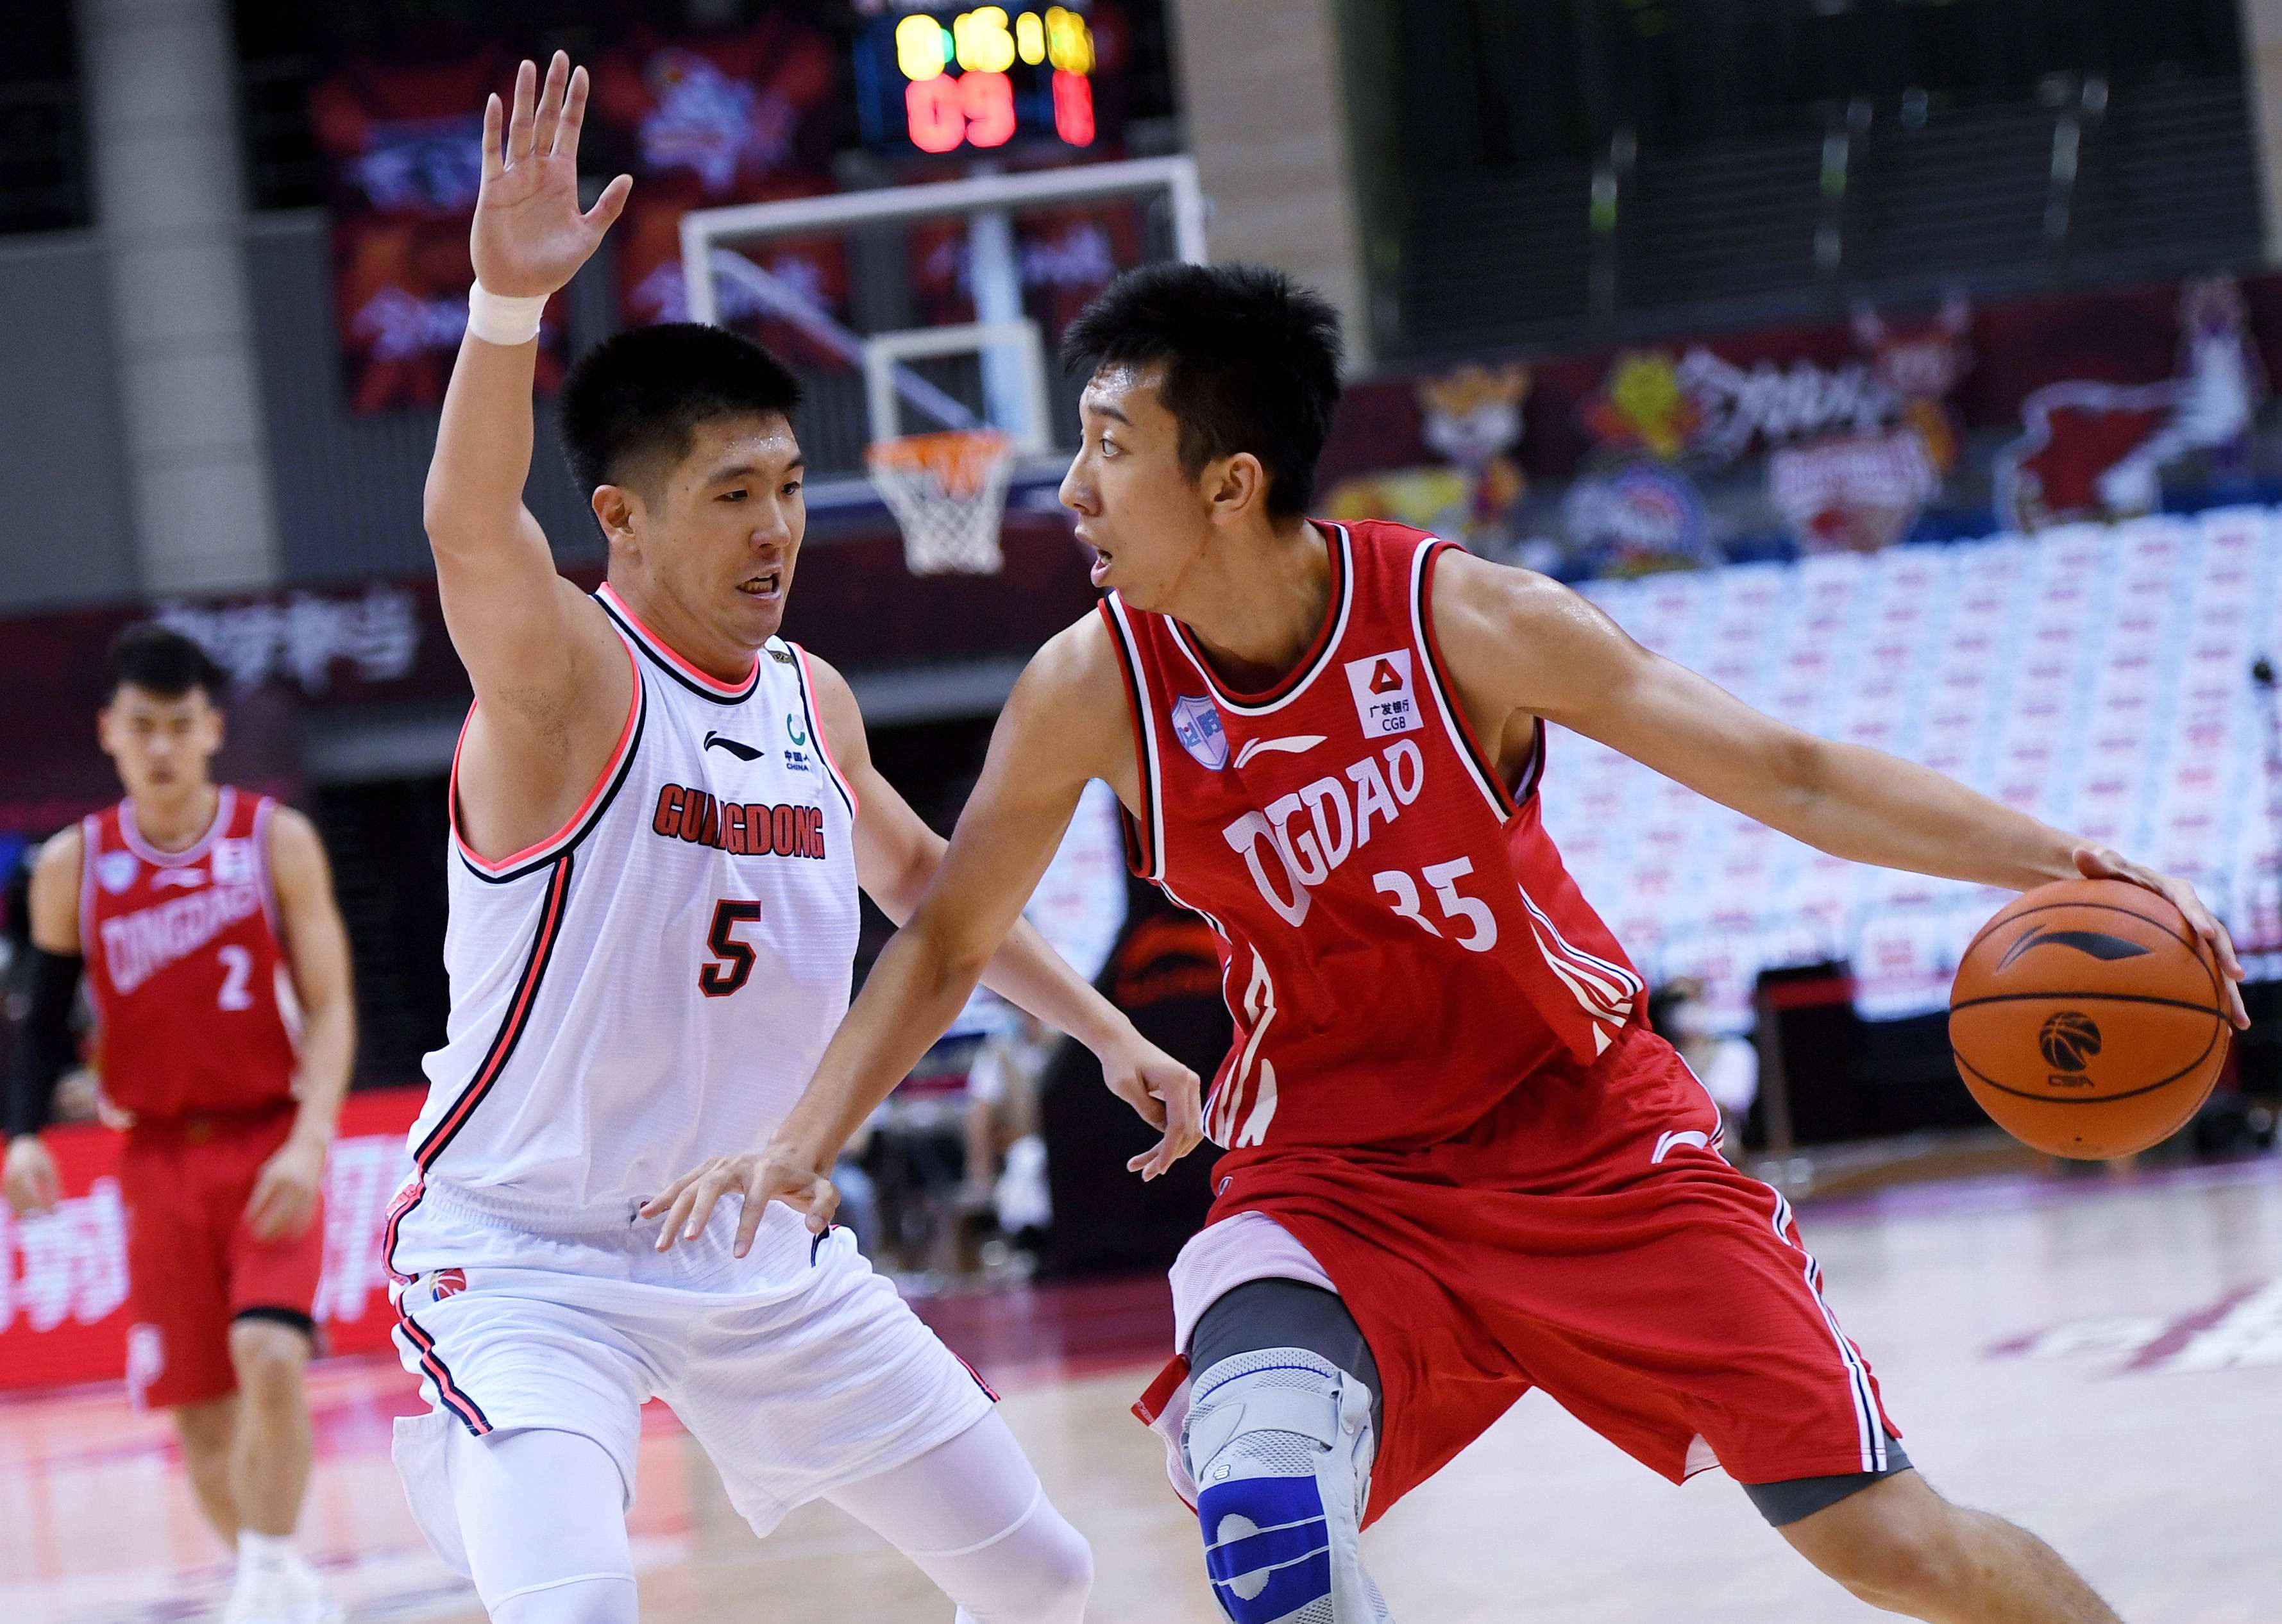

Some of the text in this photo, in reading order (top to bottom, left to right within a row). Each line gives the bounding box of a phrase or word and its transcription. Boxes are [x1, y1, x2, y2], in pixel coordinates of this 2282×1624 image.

[1369, 698, 1410, 718] 广发银行
[1382, 716, 1407, 731] CGB
[786, 763, 809, 772] CHINA
[698, 899, 762, 998] 5
[217, 943, 254, 1012] 2
